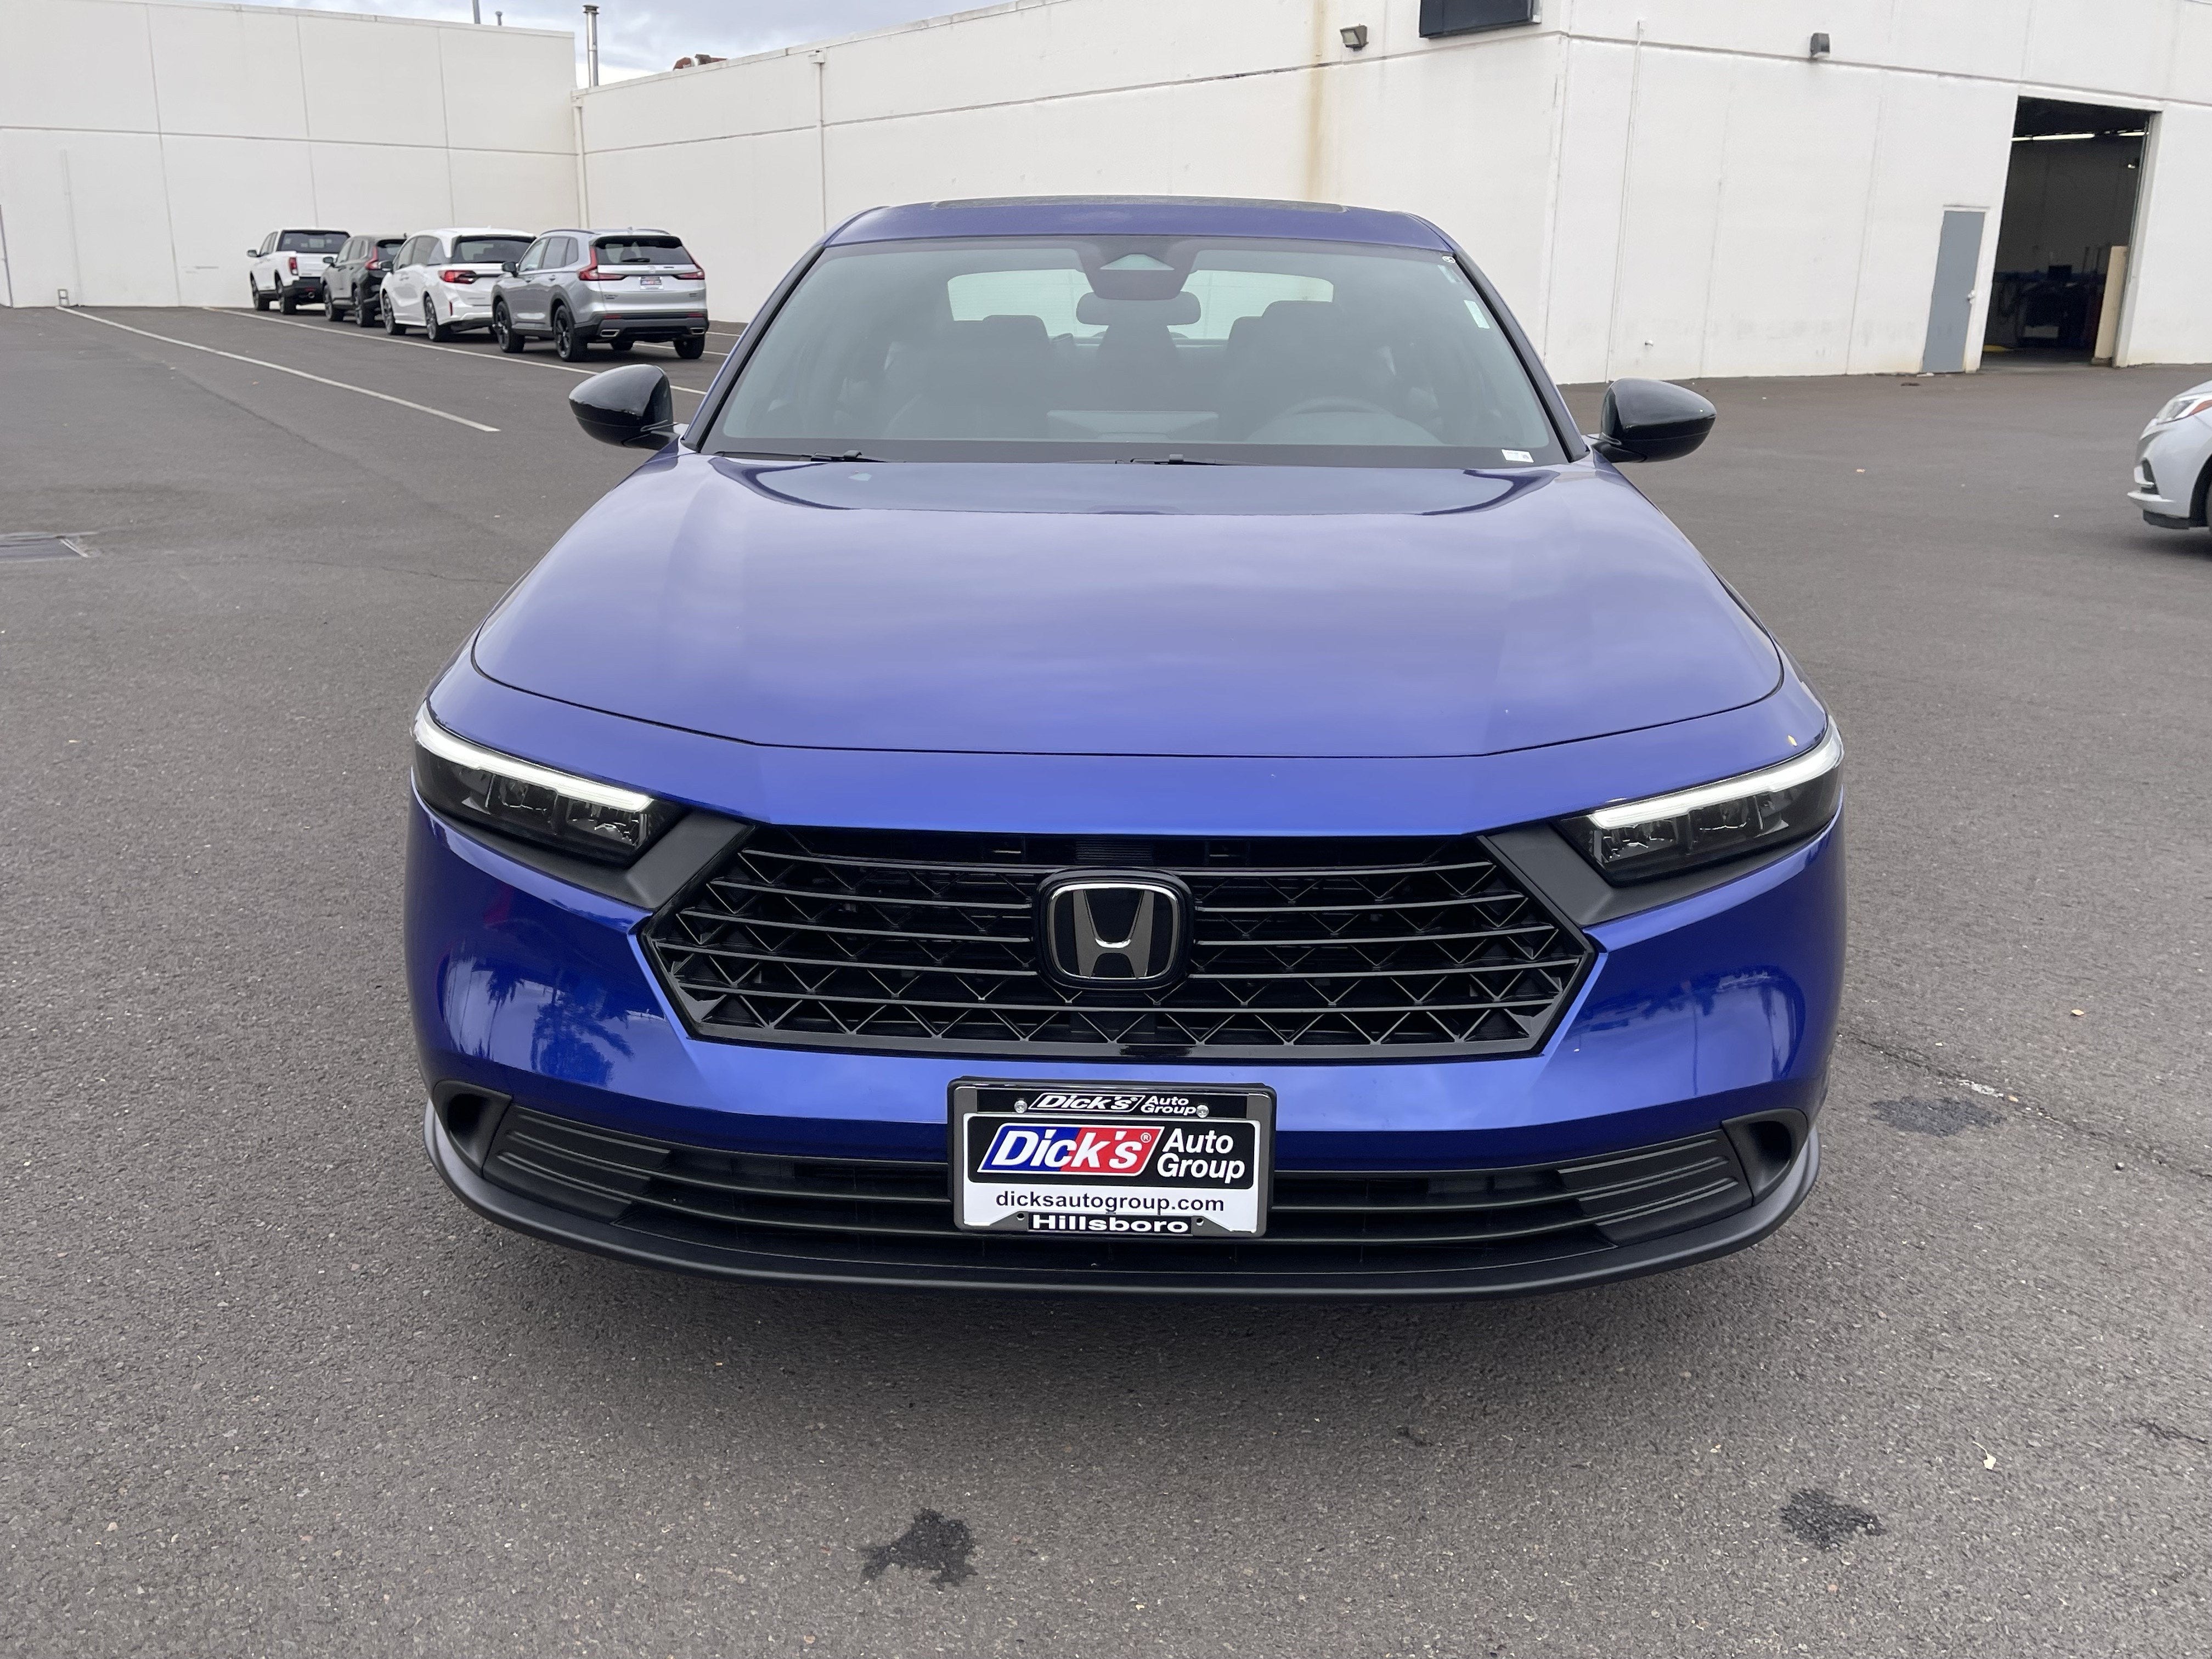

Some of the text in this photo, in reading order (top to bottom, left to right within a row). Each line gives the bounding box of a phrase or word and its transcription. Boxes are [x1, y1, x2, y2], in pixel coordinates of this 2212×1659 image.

[1141, 1103, 1197, 1116] Group
[1144, 1096, 1189, 1106] Auto
[1162, 1128, 1234, 1154] Auto
[1157, 1153, 1245, 1184] Group
[996, 1190, 1224, 1215] dicksautogroup.com
[1032, 1214, 1189, 1233] Hillsboro
